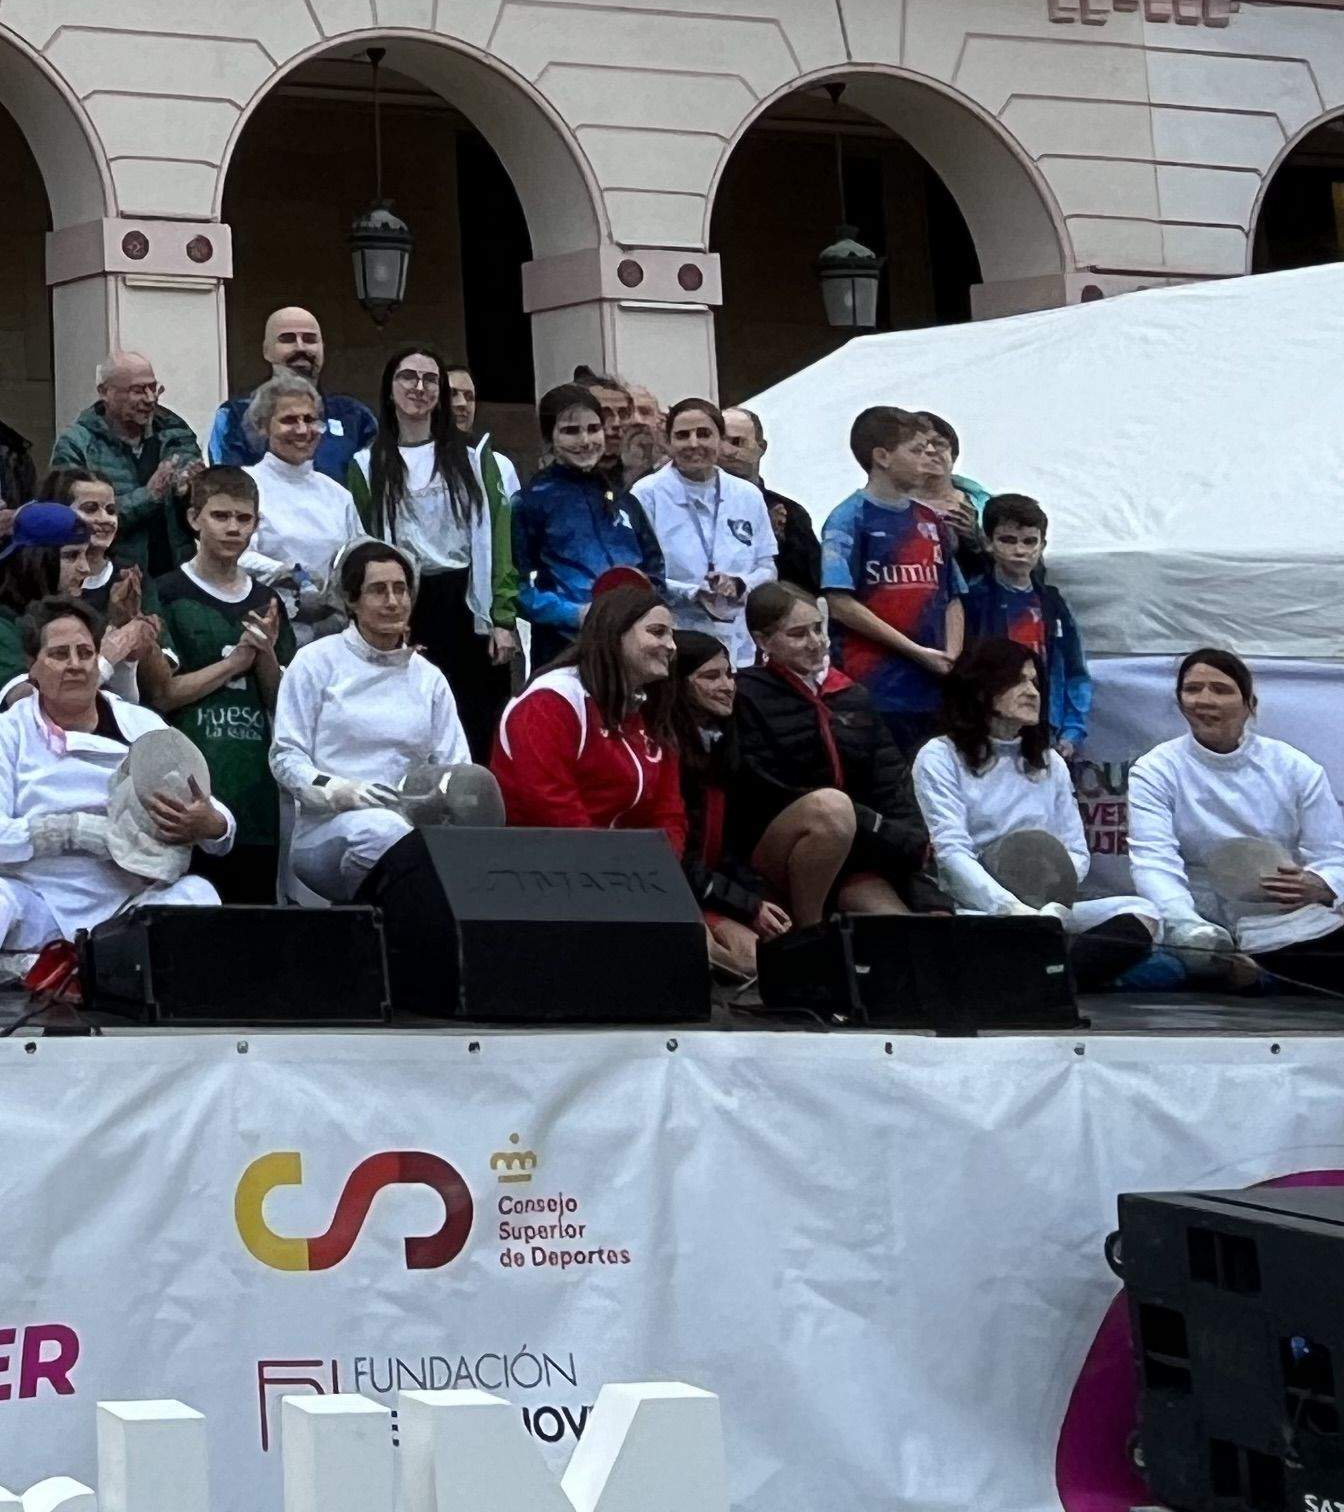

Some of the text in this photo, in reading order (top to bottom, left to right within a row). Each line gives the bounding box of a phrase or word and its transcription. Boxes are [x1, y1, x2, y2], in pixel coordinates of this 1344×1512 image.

[498, 1192, 578, 1218] Consejo
[499, 1219, 587, 1244] Superior
[500, 1246, 632, 1270] de Deportes
[354, 1343, 578, 1393] FUNDACIÓN
